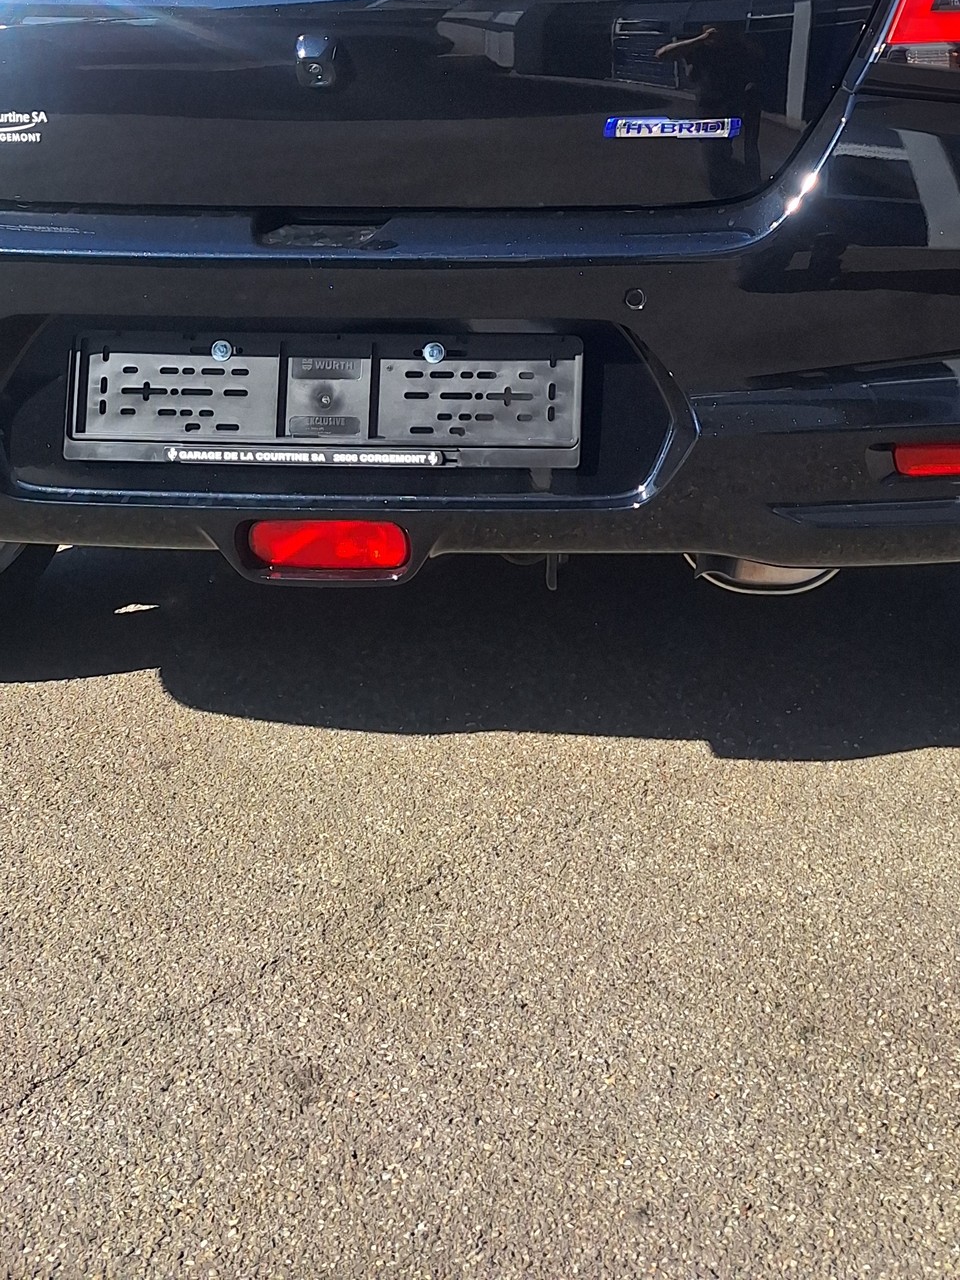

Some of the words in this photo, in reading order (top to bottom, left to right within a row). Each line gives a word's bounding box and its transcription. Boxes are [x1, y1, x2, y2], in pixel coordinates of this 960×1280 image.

[31, 111, 48, 123] SA
[625, 122, 724, 135] HYBRID
[304, 417, 345, 426] EXCLUSIVE
[179, 451, 222, 460] GARAGE
[223, 451, 239, 461] DE
[240, 452, 254, 461] LA
[255, 452, 309, 462] COURTINE
[311, 453, 326, 462] SA
[359, 453, 426, 464] CORGEMONT
